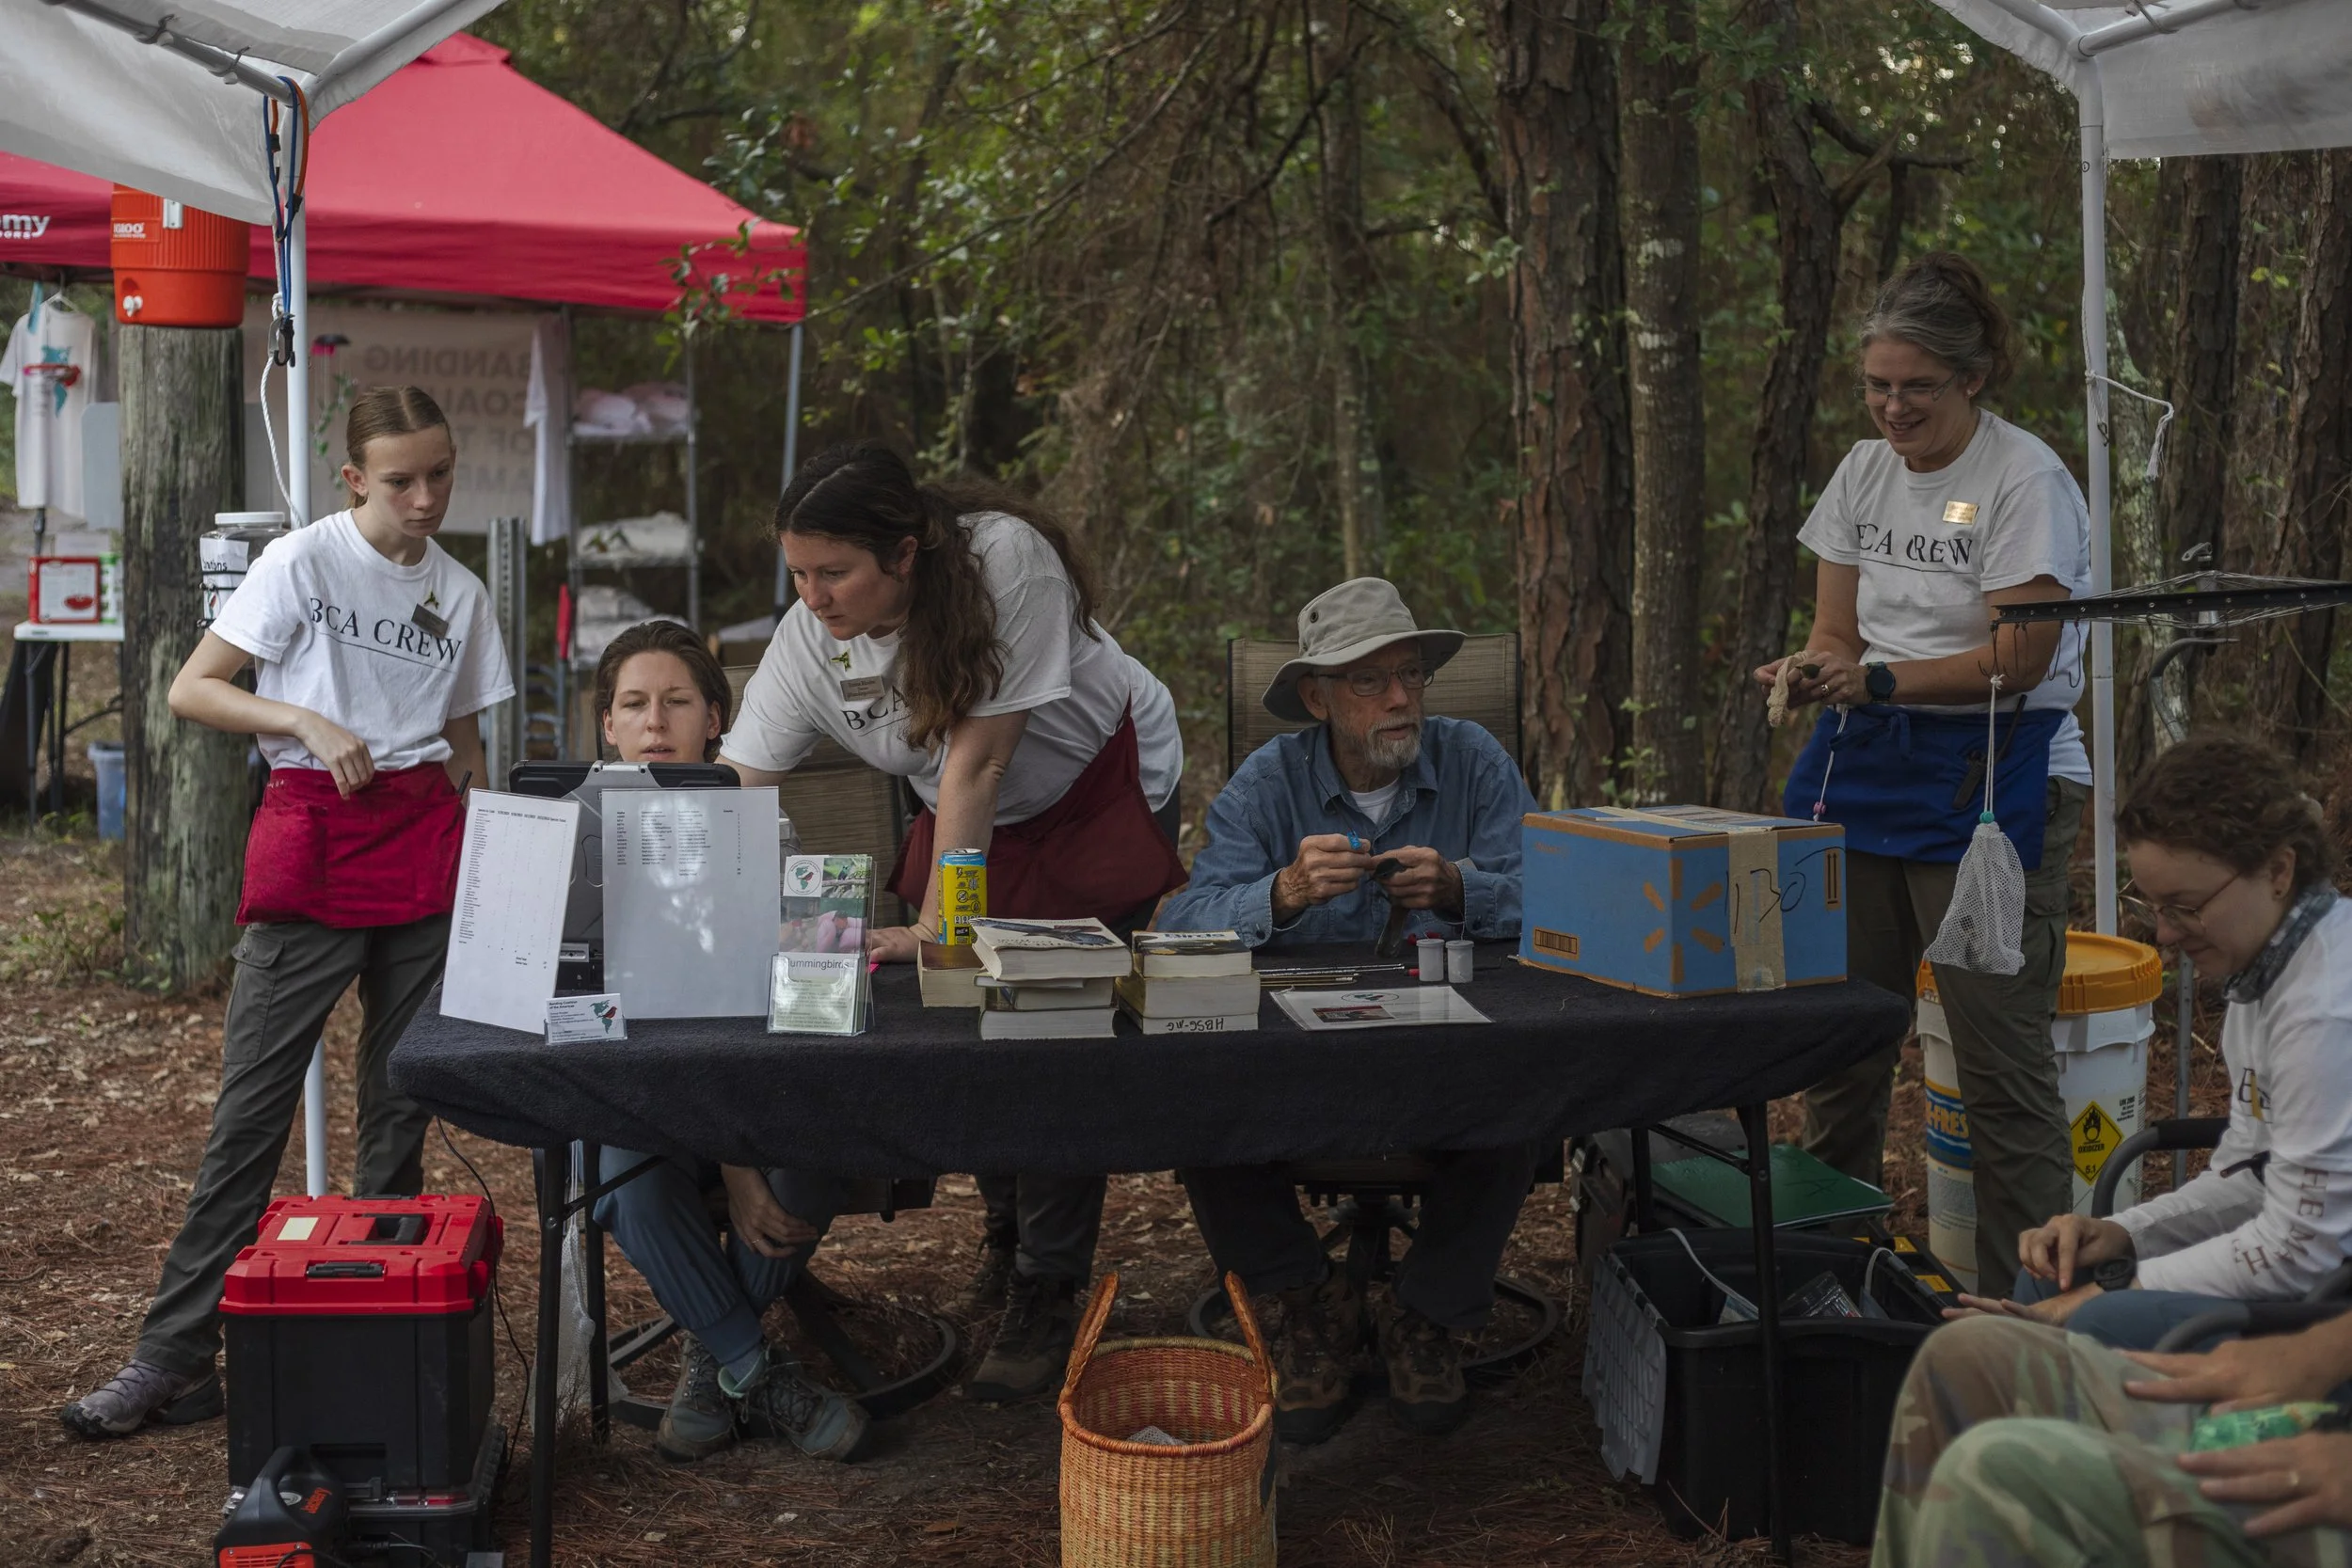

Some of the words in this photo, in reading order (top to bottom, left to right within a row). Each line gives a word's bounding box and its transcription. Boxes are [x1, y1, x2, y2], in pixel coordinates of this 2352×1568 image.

[0, 214, 51, 238] my
[0, 230, 31, 239] ORS
[1906, 534, 1973, 566] CREW
[310, 597, 359, 638] BCA
[373, 618, 462, 664] CREW
[841, 686, 910, 730] BCA
[788, 958, 850, 971] ummingbirds
[2077, 1143, 2106, 1154] OXIDIZER
[2085, 1164, 2097, 1174] 5.1
